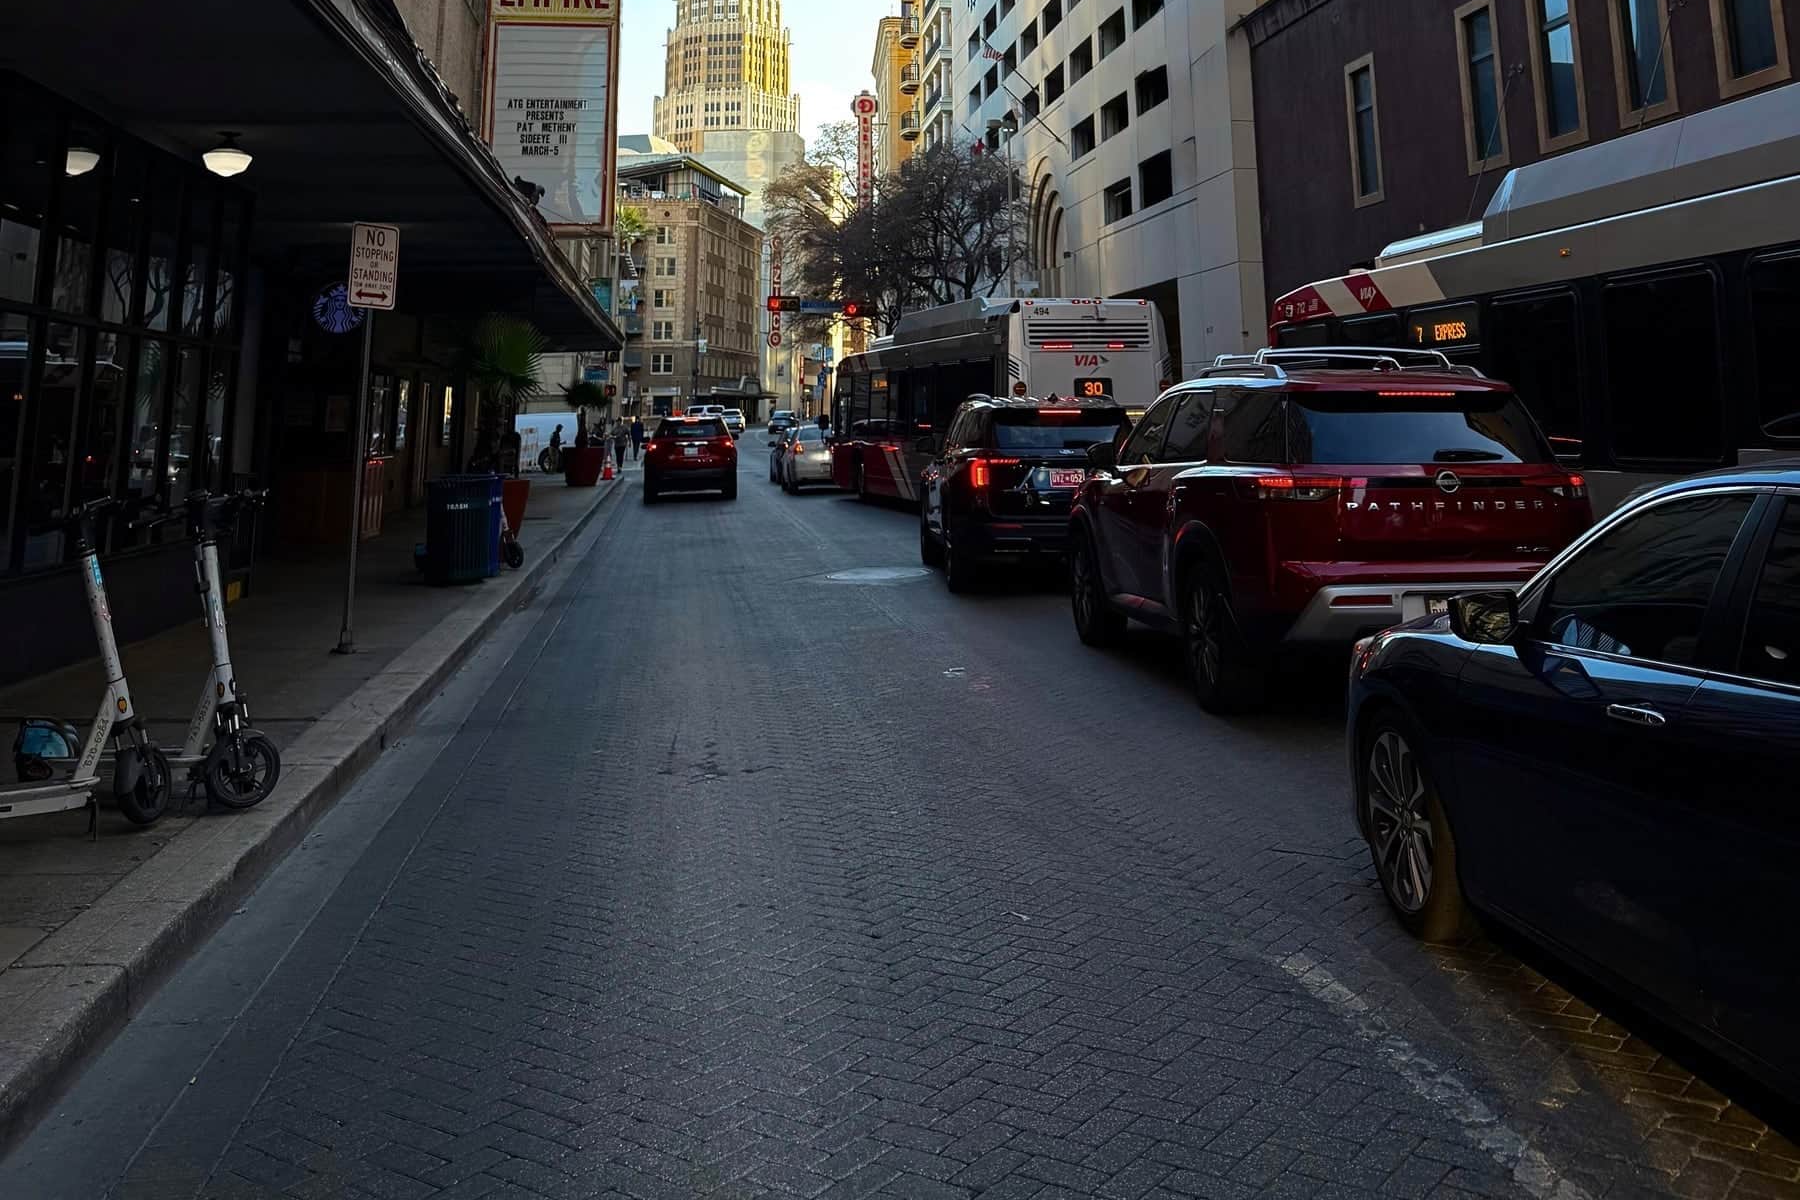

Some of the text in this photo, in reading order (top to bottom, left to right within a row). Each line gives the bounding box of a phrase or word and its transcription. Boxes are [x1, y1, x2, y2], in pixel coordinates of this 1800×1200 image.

[507, 99, 587, 109] ATG ENTERTAINMENT
[526, 110, 564, 121] PRESENTS
[516, 122, 576, 133] PAT METHENY
[519, 134, 567, 144] SIDEEYE III
[521, 146, 559, 156] MARCH-5
[367, 229, 385, 247] NO
[356, 246, 393, 262] STOPPING
[354, 268, 393, 283] STANDING
[1033, 307, 1050, 316] 494
[1434, 322, 1467, 341] EXPRESS
[1074, 355, 1098, 367] VIA
[1084, 382, 1103, 396] 30
[1346, 500, 1544, 511] PATHFINDER
